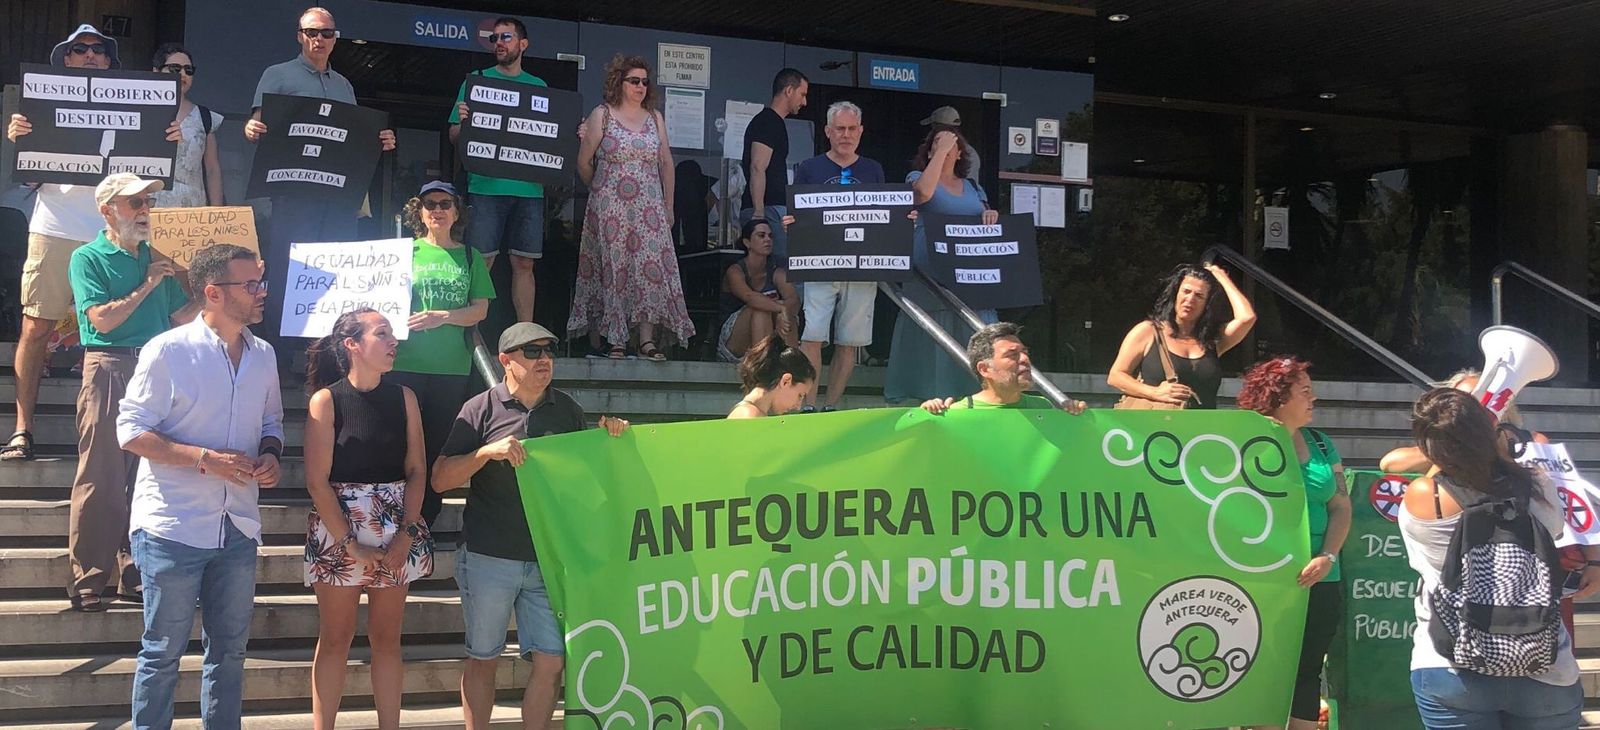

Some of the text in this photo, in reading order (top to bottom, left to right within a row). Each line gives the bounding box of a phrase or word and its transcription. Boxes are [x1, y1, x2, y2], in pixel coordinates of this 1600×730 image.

[415, 21, 469, 40] SALIDA
[664, 50, 705, 60] EN ESTE CENTRO
[679, 62, 703, 71] PROHIBIDO
[873, 66, 916, 82] ENTRADA
[24, 82, 175, 101] NUESTRO GOBIERNO
[474, 88, 548, 109] MUERE EL
[321, 105, 330, 113] Y
[57, 112, 138, 126] DESTRUYE
[472, 115, 558, 135] CEIP INFANTE
[291, 125, 346, 140] FAVORECE
[304, 146, 319, 155] LA
[468, 144, 563, 166] DON FERNANDO
[18, 158, 165, 175] EDUCACIÓN PÚBLICA
[270, 171, 341, 185] CONCERTADA
[800, 193, 912, 204] NUESTRO GOBIERNO
[157, 210, 237, 225] IGUALDAD
[824, 213, 889, 222] DISCRIMINA
[153, 223, 249, 240] PARA L@S NIÑ@S
[845, 231, 859, 239] LA
[946, 226, 999, 235] APOYAMOS
[181, 239, 216, 247] DE LA
[935, 243, 946, 251] LA
[304, 252, 400, 270] IGUALDAD
[789, 255, 906, 267] EDUCACIÓN PÚBLICA
[295, 274, 338, 290] PARA
[295, 303, 317, 315] DE
[320, 301, 337, 314] LA
[628, 488, 1157, 562] ANTEQUERA POR UNA
[636, 546, 1122, 635] EDUCACIÓN PÚBLICA
[1159, 589, 1248, 614] MAREA VERDE
[1165, 605, 1239, 626] ANTEQUERA
[741, 624, 1046, 683] Y DE CALIDAD
